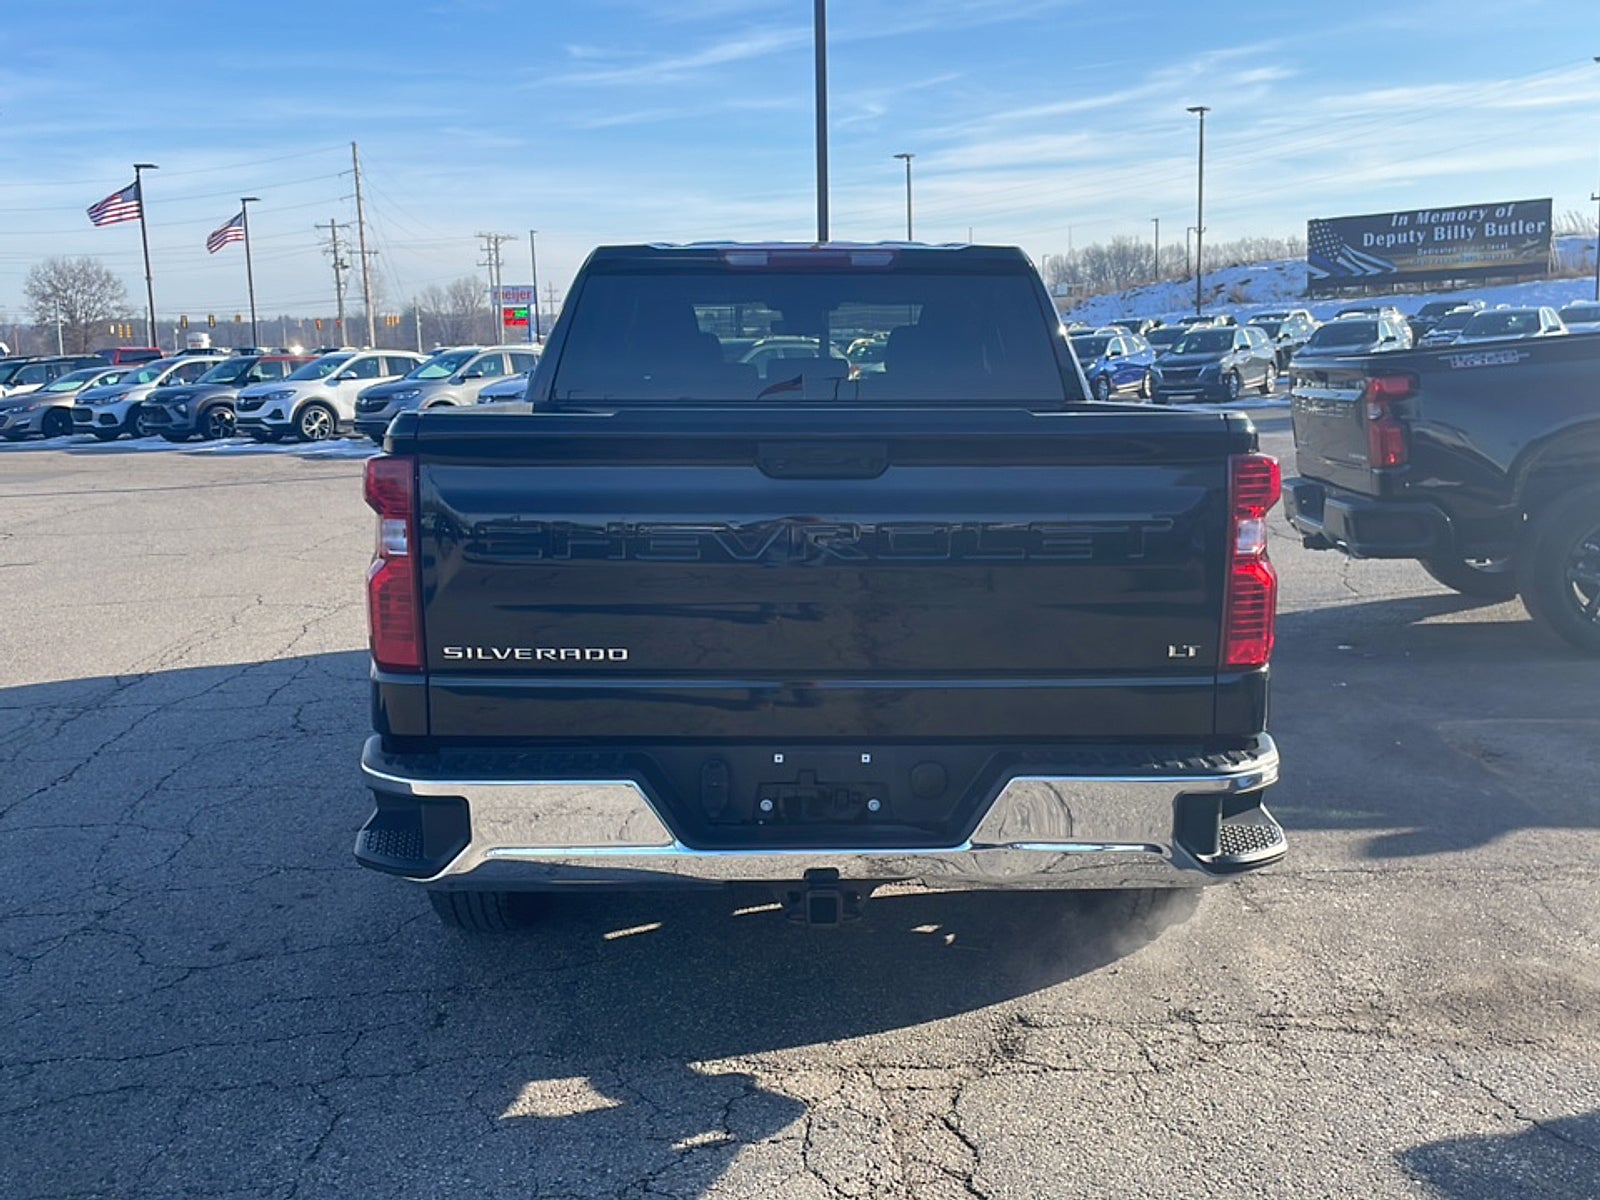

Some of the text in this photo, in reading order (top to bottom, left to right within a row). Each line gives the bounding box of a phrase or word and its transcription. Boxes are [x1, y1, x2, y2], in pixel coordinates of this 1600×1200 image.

[1391, 204, 1514, 227] In Memory of
[1363, 221, 1546, 248] Deputy Billy Butler
[473, 518, 1174, 561] CHEVROLET
[442, 646, 629, 661] SILVERADO
[1167, 644, 1201, 658] LT
